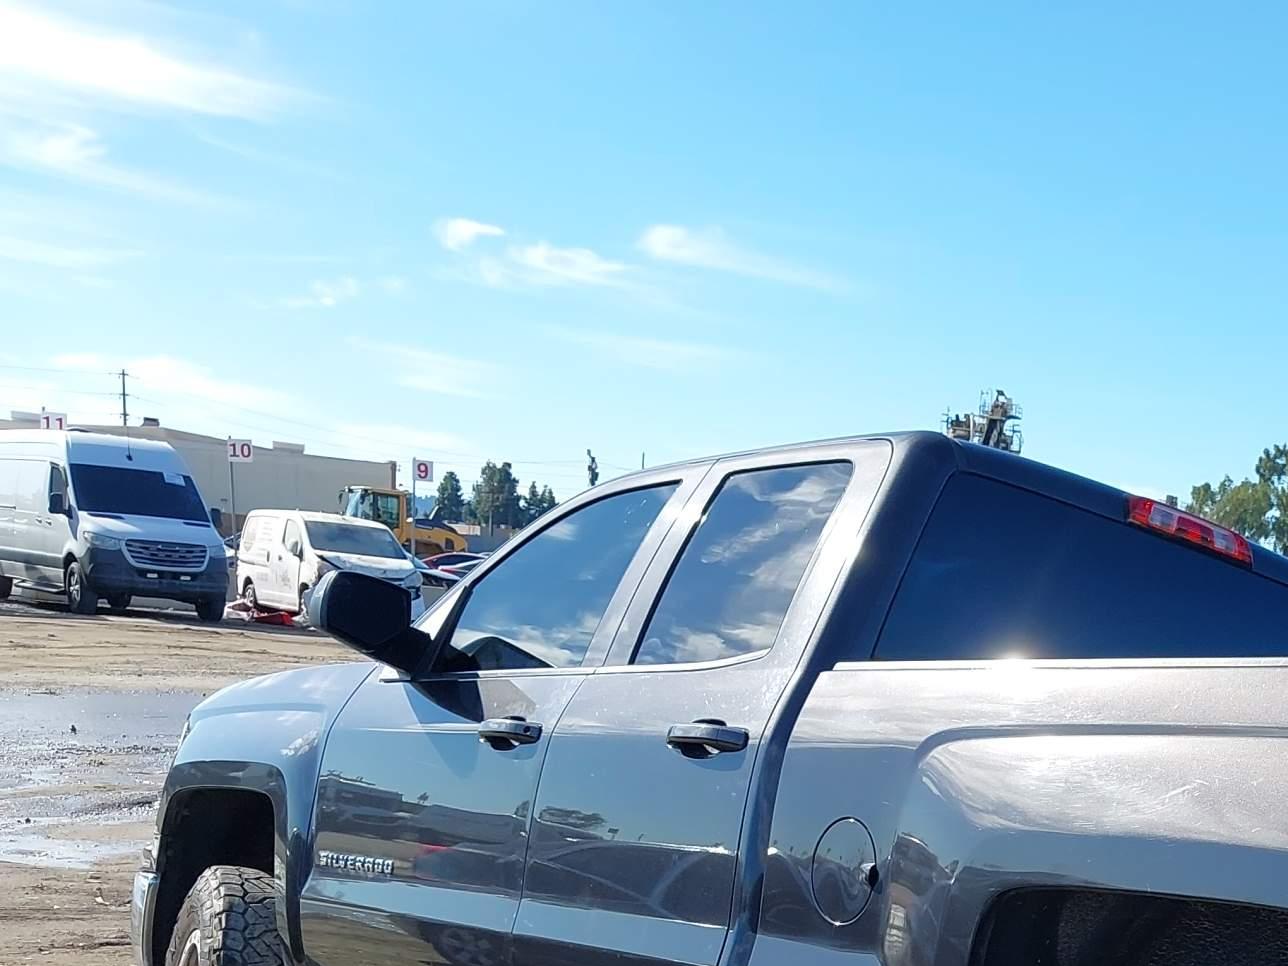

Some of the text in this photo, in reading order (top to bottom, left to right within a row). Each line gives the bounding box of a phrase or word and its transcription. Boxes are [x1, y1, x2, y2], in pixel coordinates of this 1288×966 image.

[42, 415, 64, 430] 11
[228, 442, 252, 459] 10
[416, 462, 430, 479] 9
[318, 850, 394, 874] SILVERADO
